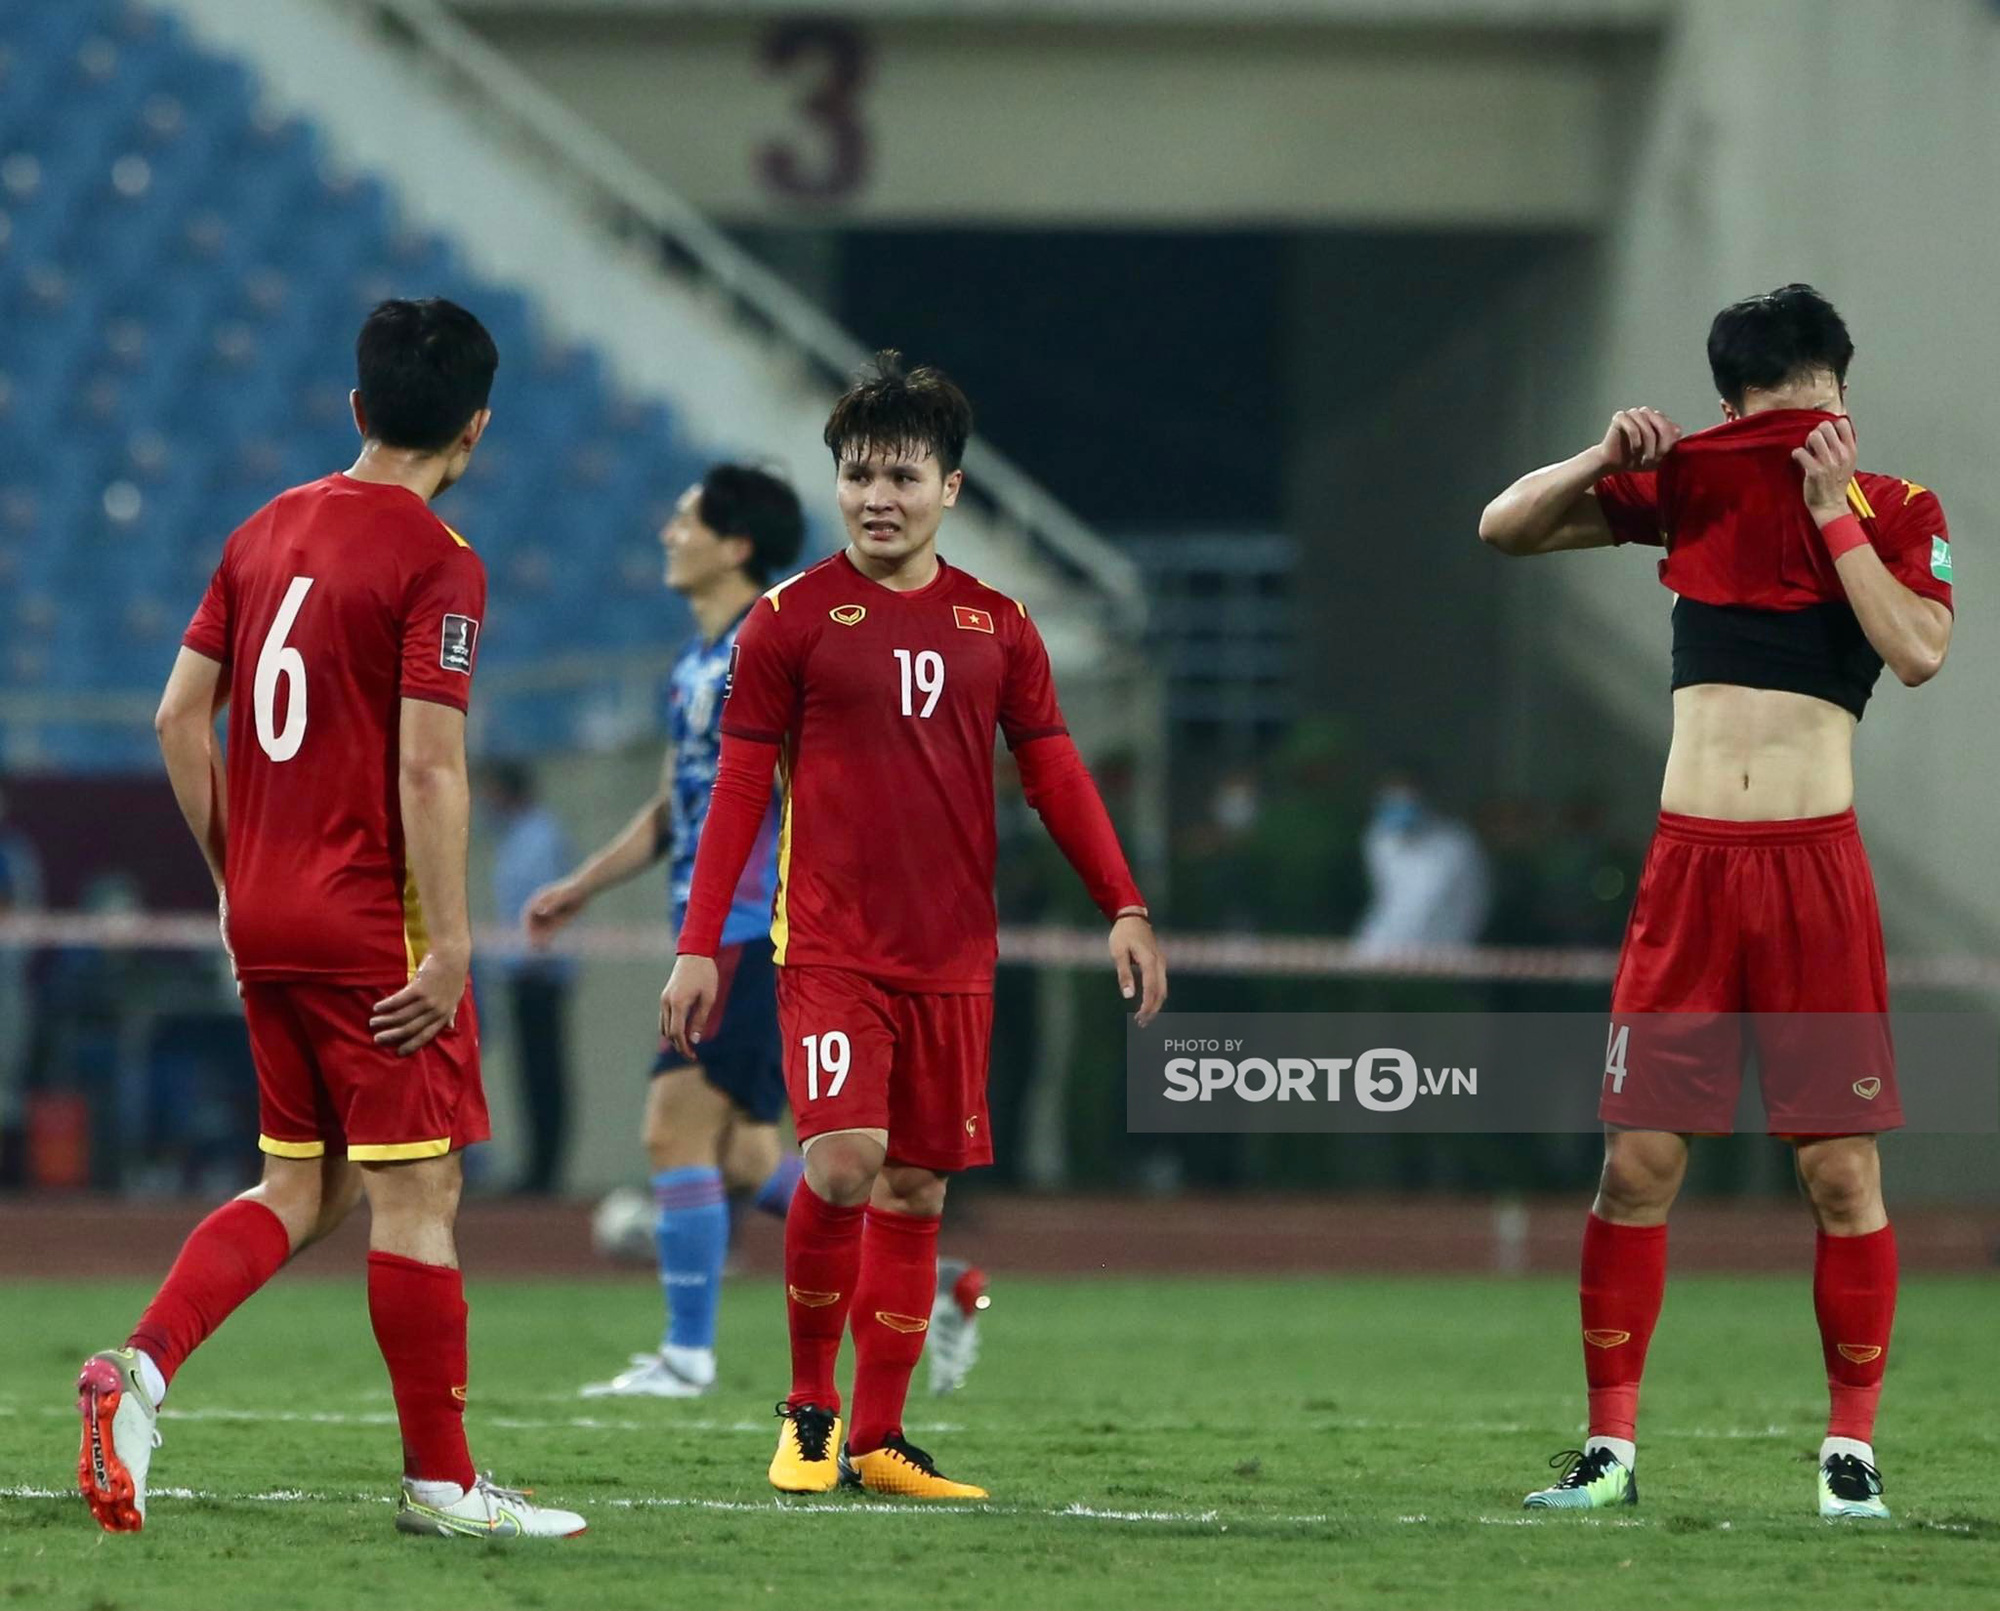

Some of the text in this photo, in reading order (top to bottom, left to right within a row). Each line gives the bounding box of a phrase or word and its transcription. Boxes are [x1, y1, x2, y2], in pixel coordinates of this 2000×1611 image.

[755, 16, 876, 204] 3
[253, 576, 315, 762] 6
[893, 649, 945, 718] 19
[802, 1030, 851, 1101] 19
